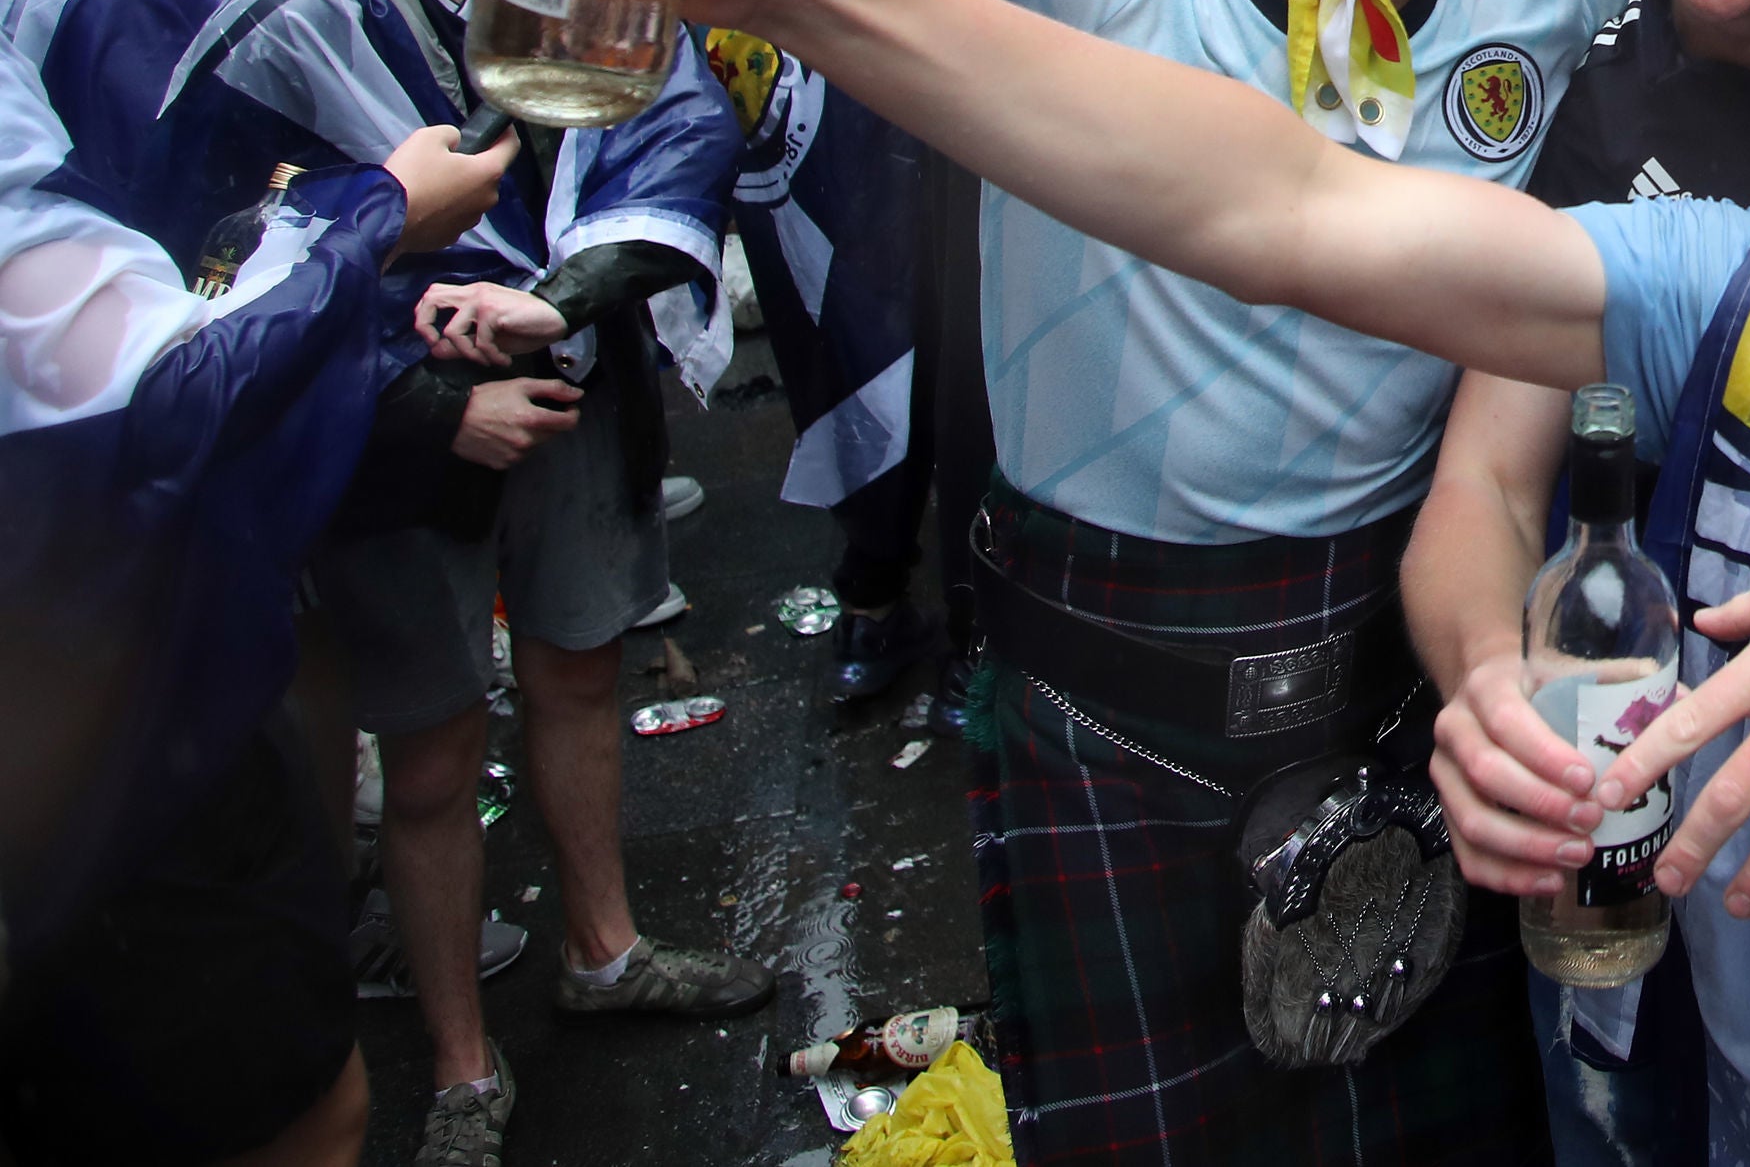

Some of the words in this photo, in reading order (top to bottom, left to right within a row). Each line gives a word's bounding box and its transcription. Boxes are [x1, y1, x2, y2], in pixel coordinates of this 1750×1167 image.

[1464, 50, 1515, 68] SCOTLAND
[1468, 139, 1482, 152] EST
[890, 1040, 929, 1064] BIRRA
